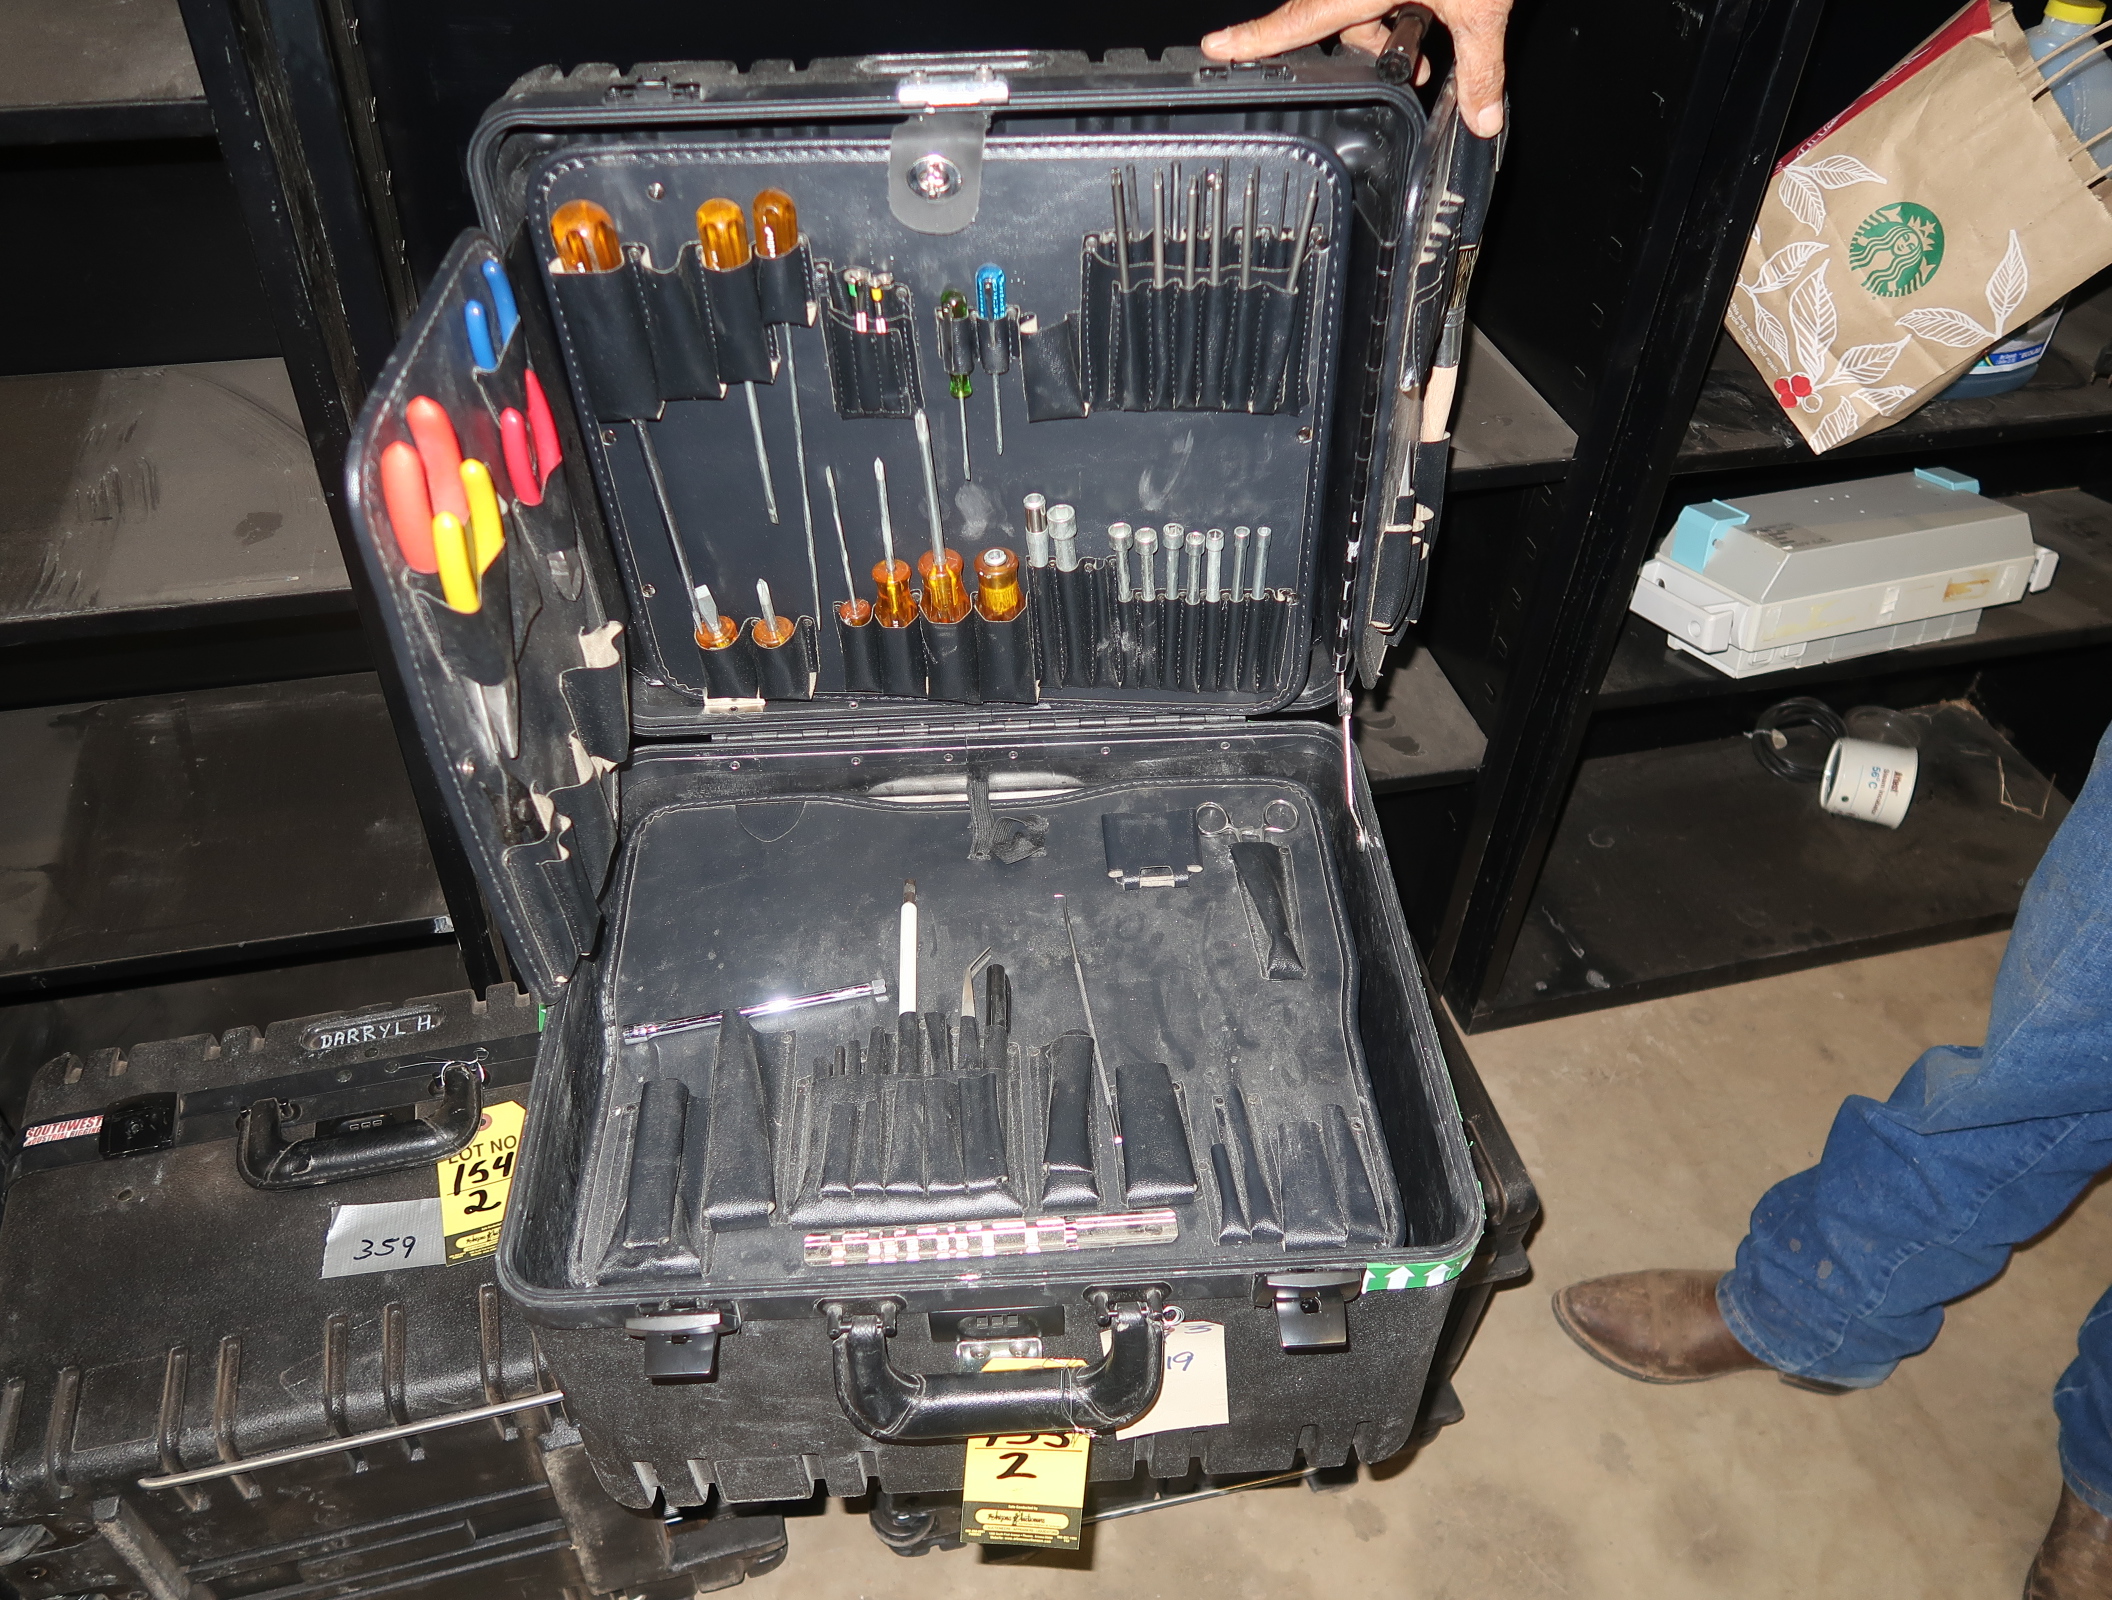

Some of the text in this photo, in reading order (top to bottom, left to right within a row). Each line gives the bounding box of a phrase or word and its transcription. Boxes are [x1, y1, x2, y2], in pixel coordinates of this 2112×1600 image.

[1757, 345, 1768, 357] and
[320, 1014, 436, 1049] DARRYL H.
[26, 1115, 104, 1138] SOUTHWEST
[490, 1135, 517, 1153] NO
[453, 1151, 514, 1196] 154
[464, 1189, 502, 1215] 2
[353, 1235, 416, 1260] 359
[996, 1452, 1037, 1479] 2
